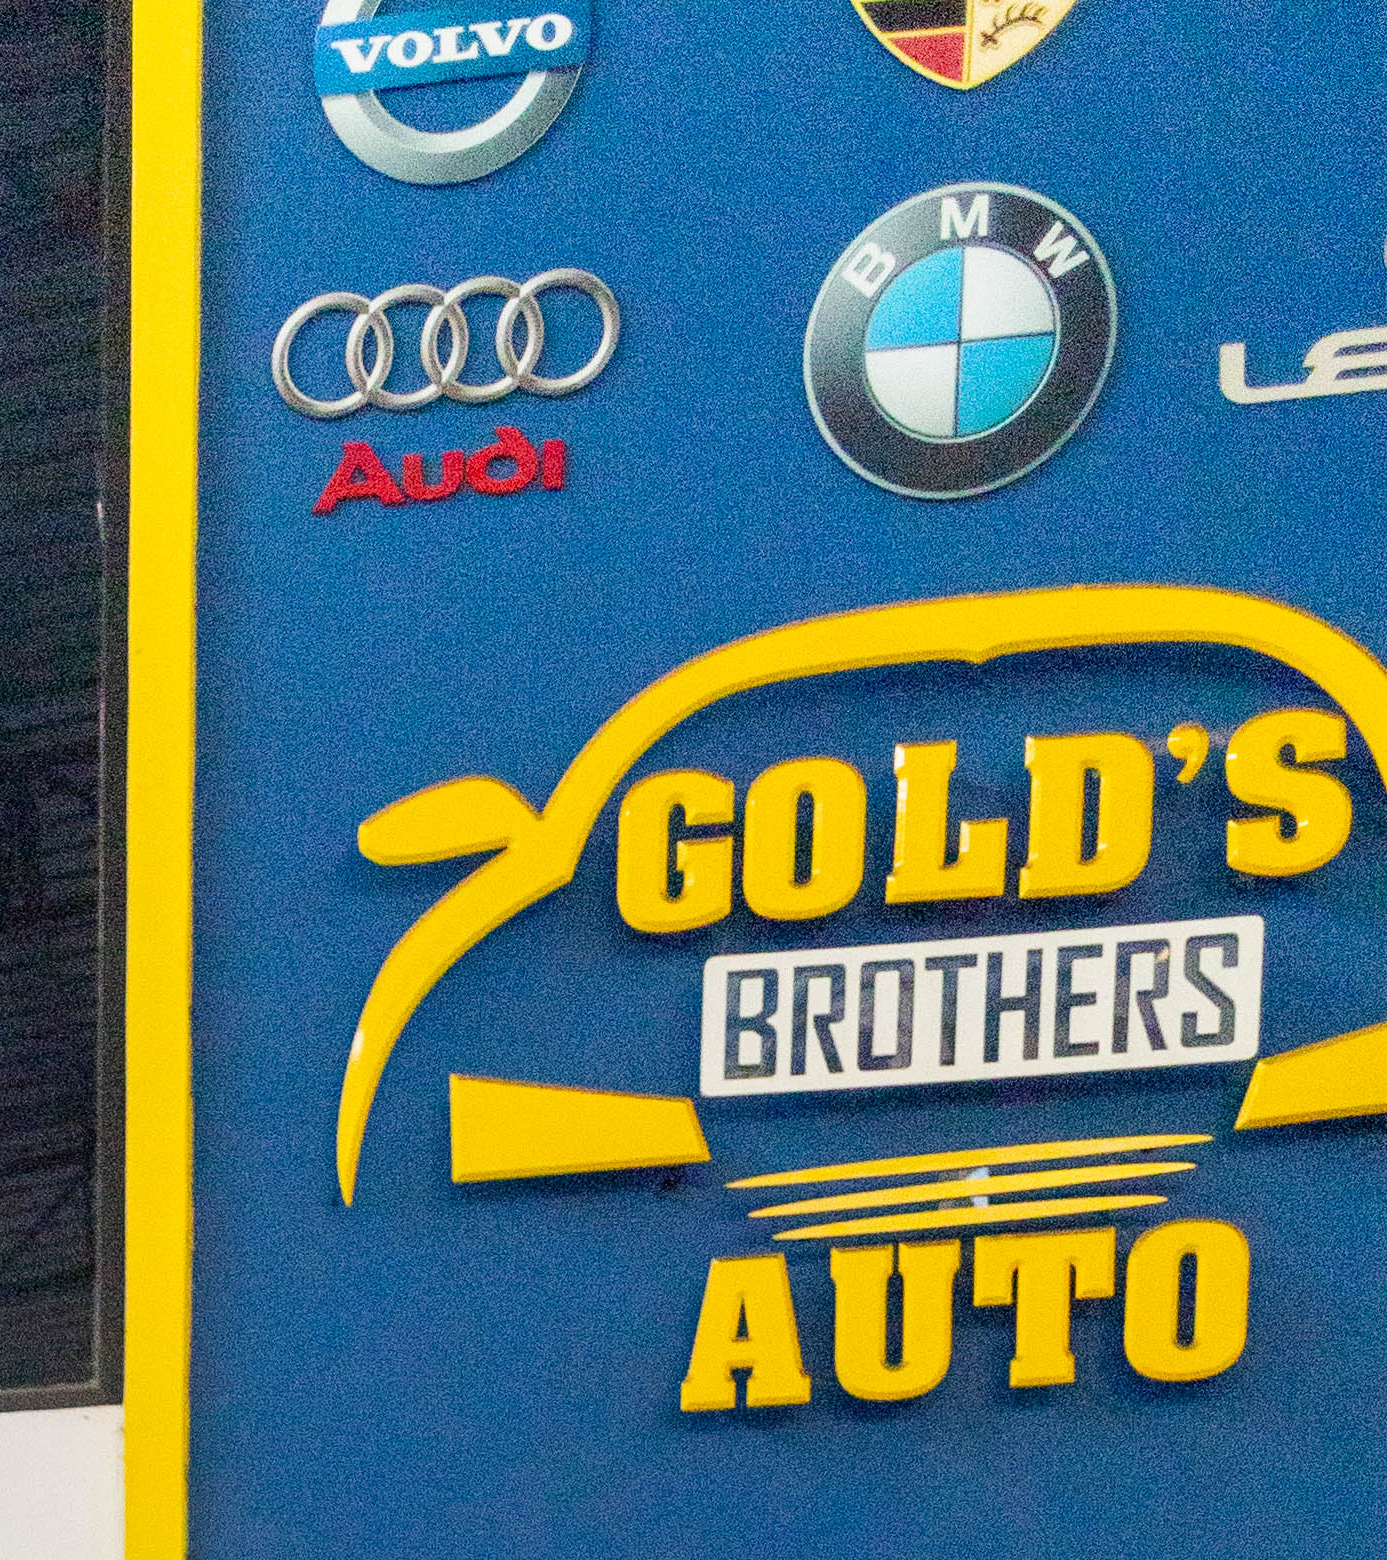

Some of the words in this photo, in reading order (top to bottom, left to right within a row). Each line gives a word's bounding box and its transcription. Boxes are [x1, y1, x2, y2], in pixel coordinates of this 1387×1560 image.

[332, 14, 573, 76] VOLVO
[841, 193, 1090, 300] BMW
[313, 427, 567, 513] Audi
[617, 709, 1354, 934] GOLD'S
[723, 933, 1239, 1081] BROTHERS
[680, 1219, 1251, 1412] AUTO
